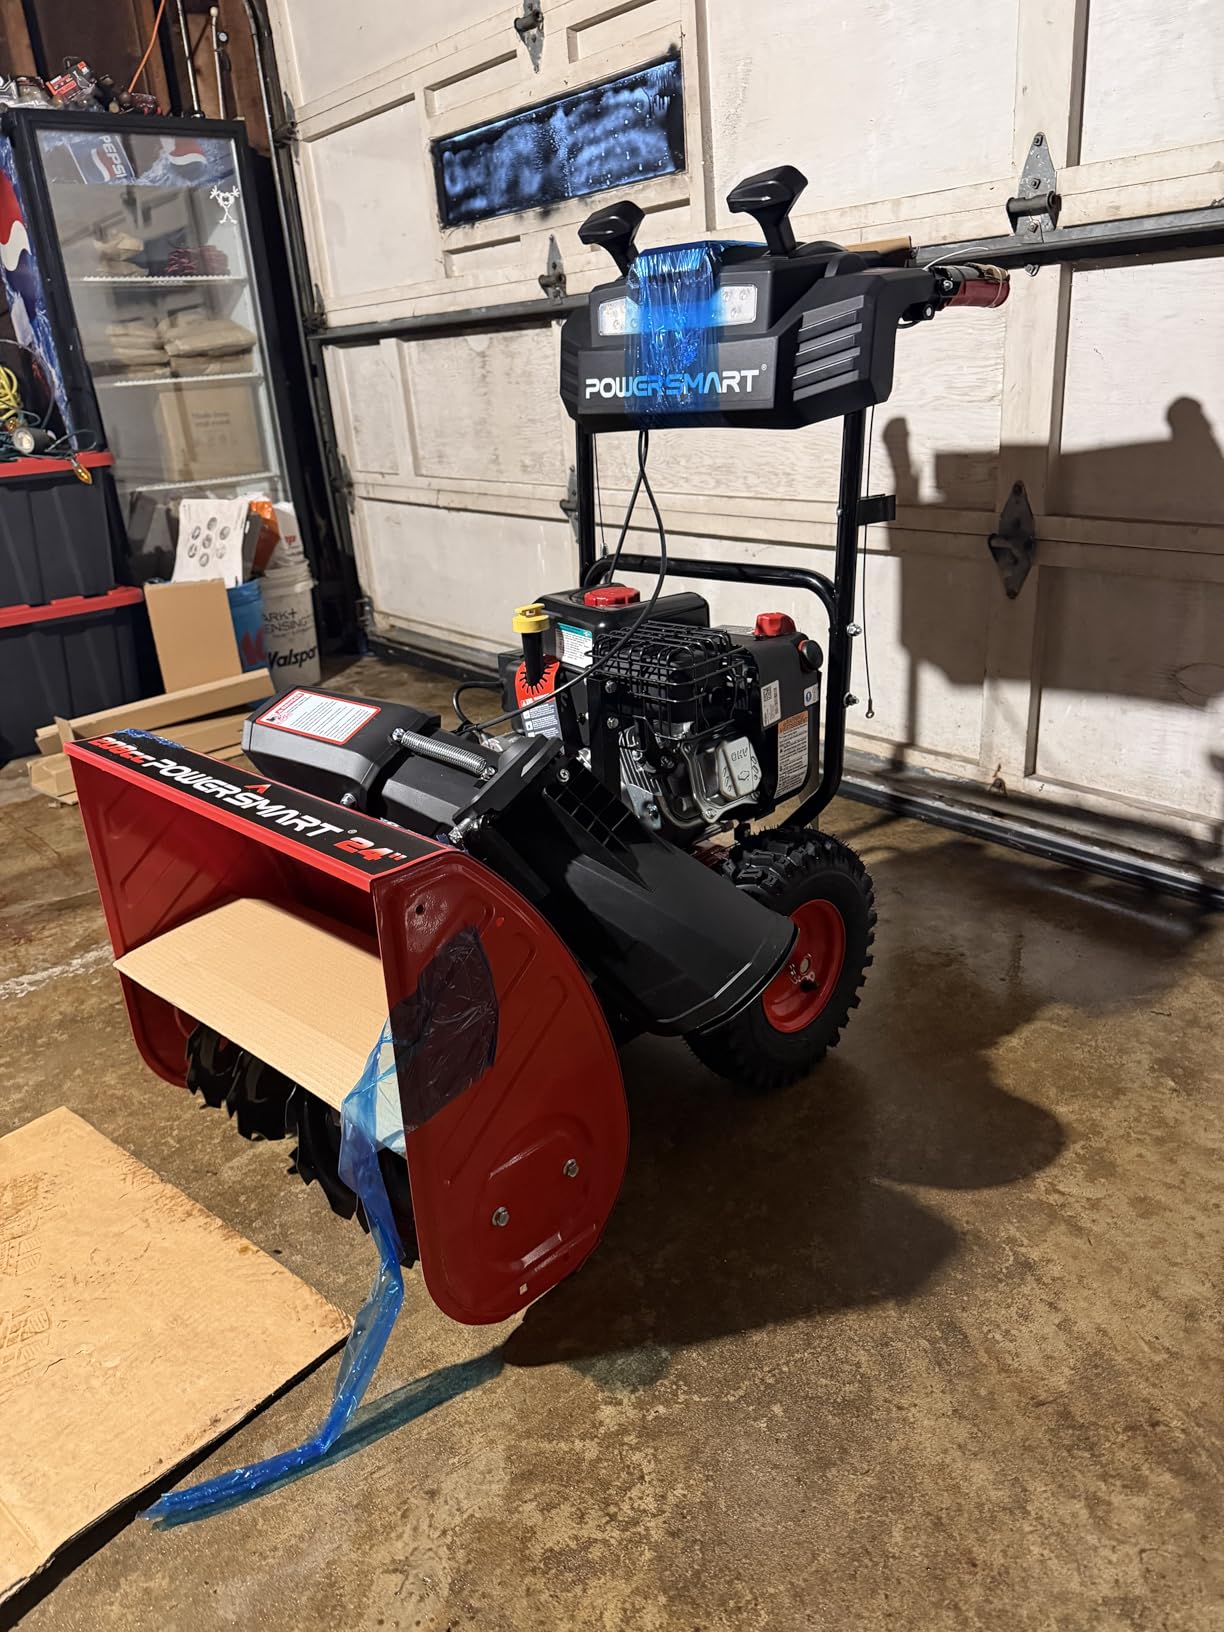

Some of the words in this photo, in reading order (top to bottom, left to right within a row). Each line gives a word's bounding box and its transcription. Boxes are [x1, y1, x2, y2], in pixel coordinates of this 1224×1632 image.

[99, 135, 128, 179] PEPSI
[585, 369, 760, 400] POWERSMART
[268, 648, 317, 669] Valspa
[142, 758, 344, 837] POWERSMART
[333, 836, 408, 861] 24"
